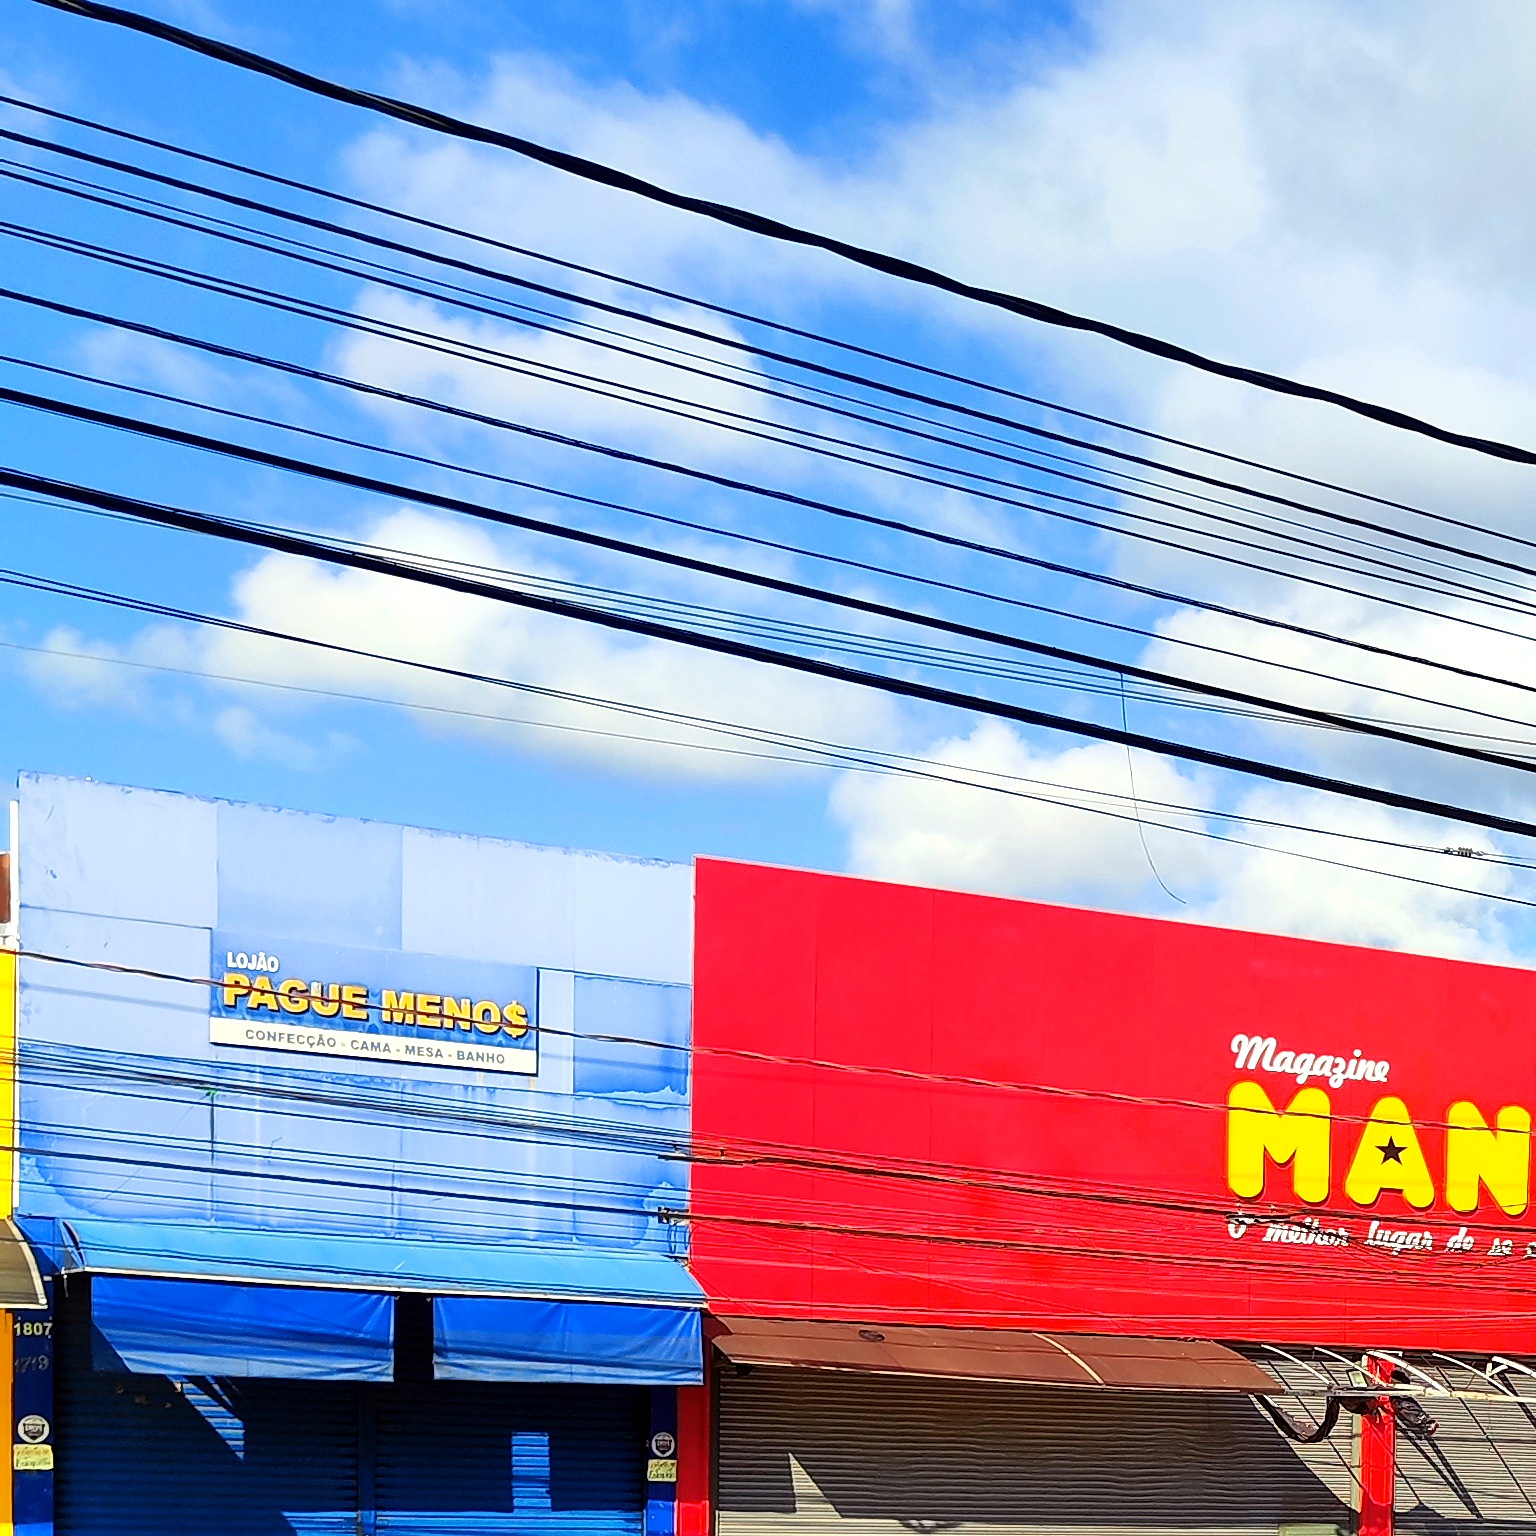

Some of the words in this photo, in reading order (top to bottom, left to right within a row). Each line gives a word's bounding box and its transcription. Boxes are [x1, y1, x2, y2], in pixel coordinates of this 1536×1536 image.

[226, 951, 280, 973] LOJÃO
[223, 972, 368, 1020] PAGUE
[245, 1028, 337, 1049] CONFECÇÃO
[350, 1039, 392, 1054] CAMA
[404, 1044, 444, 1059] MESA
[456, 1050, 506, 1065] BANHO
[1230, 1033, 1391, 1089] Magazine
[1363, 1220, 1434, 1255] lugar
[1444, 1227, 1476, 1253] de
[13, 1321, 54, 1337] 1807
